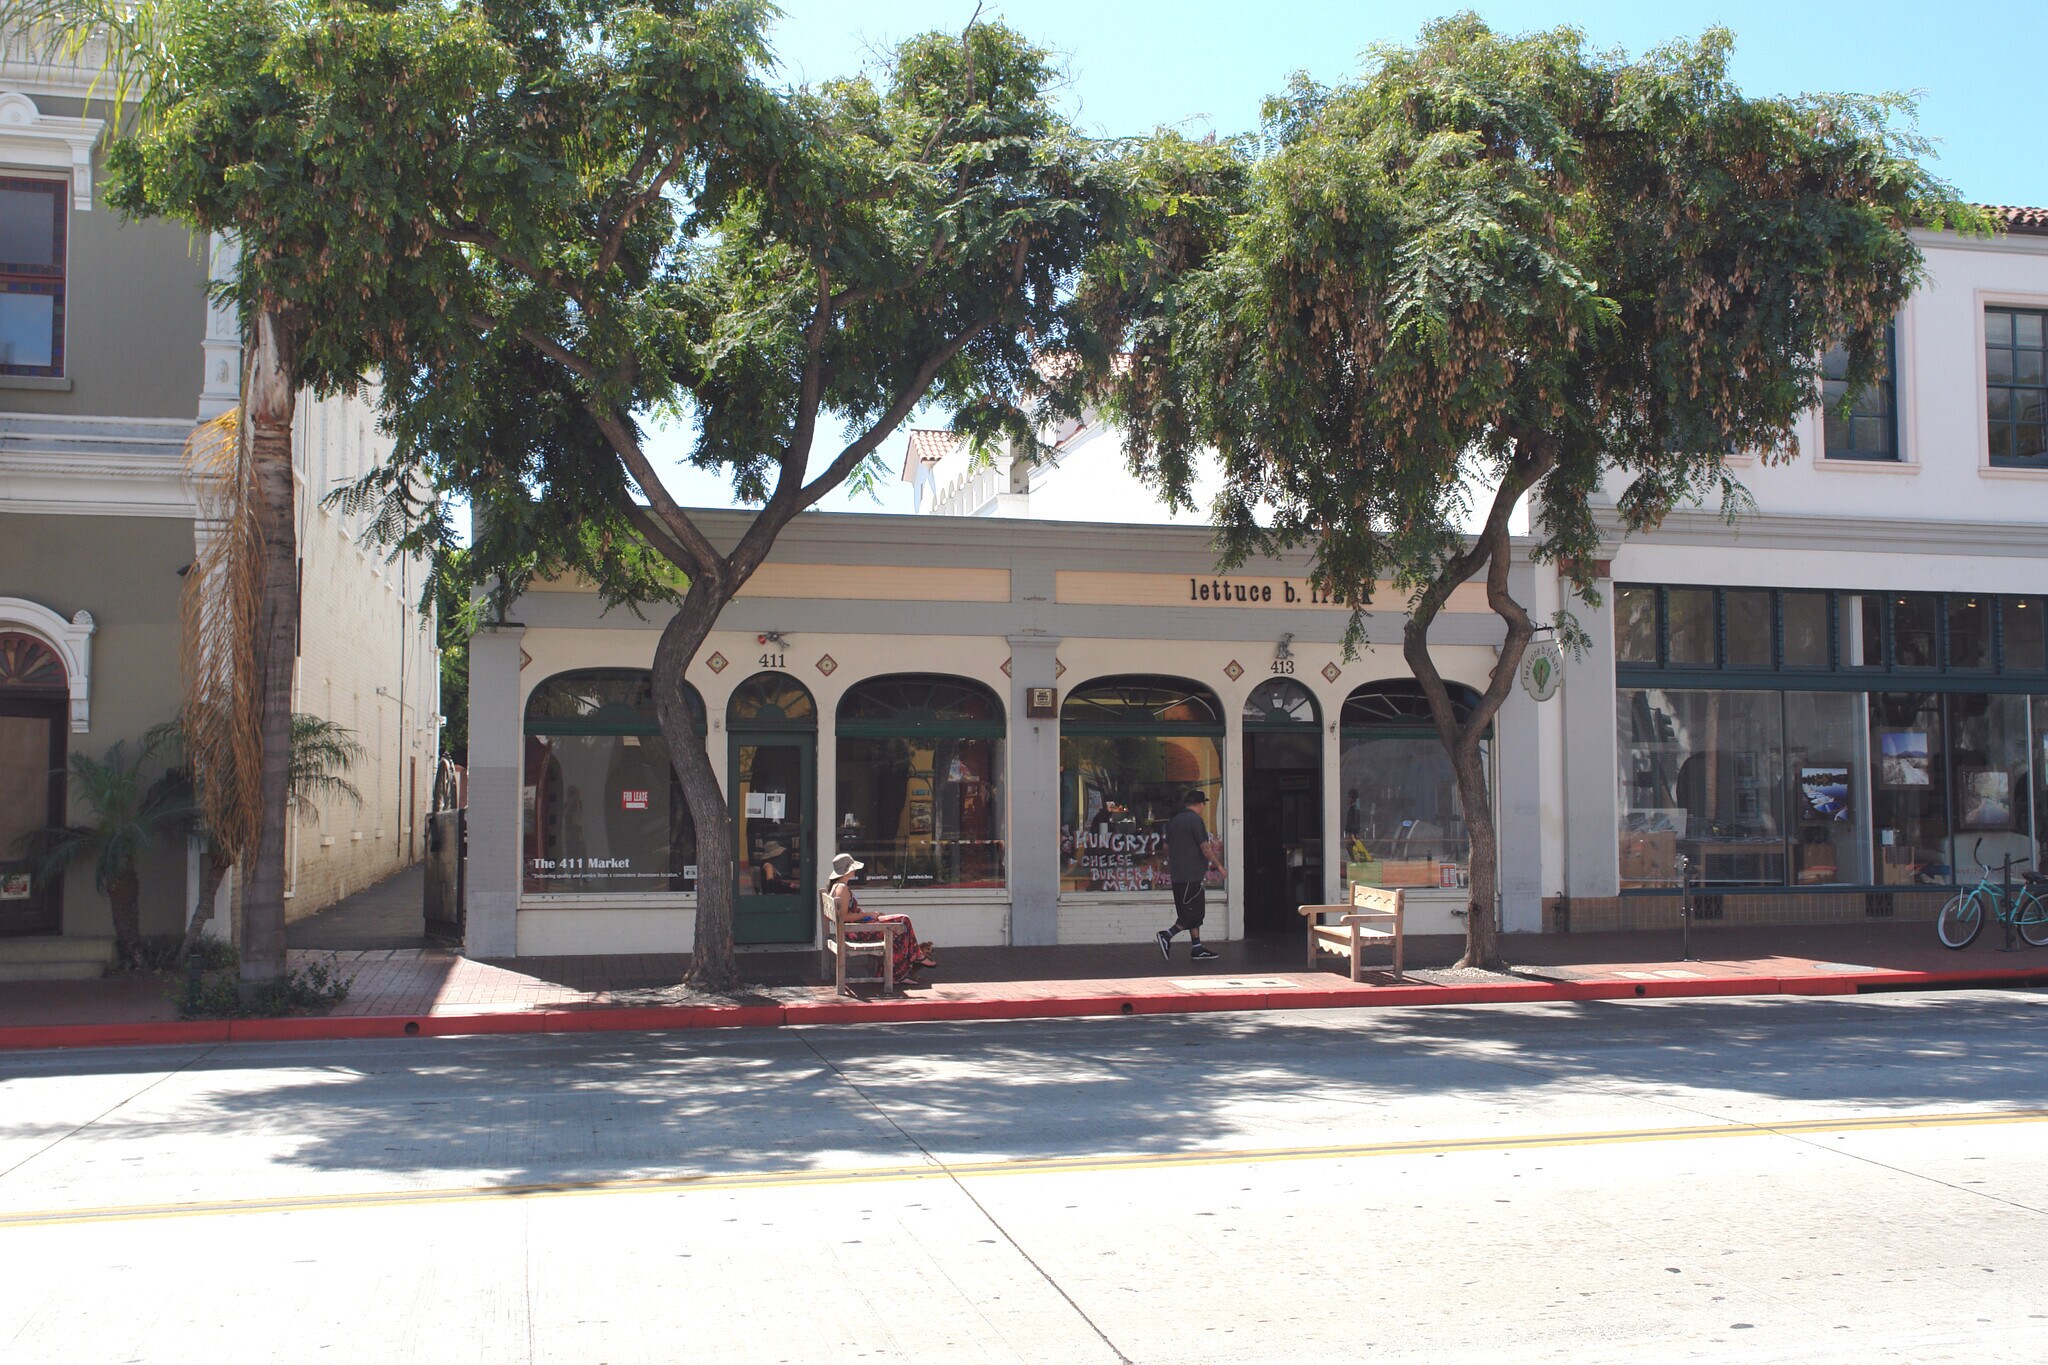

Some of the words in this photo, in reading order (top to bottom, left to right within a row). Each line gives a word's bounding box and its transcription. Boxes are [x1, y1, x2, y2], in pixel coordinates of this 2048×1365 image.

[1191, 578, 1271, 602] lettuce
[1284, 580, 1301, 603] b.
[758, 653, 786, 668] 411
[1270, 660, 1295, 674] 413
[623, 791, 632, 801] FOR
[633, 791, 648, 801] LEASE
[1075, 831, 1160, 855] HUNGRY?
[533, 858, 556, 869] The
[559, 858, 583, 869] 411
[588, 857, 630, 869] Market
[1081, 854, 1133, 867] CHEESE
[1090, 868, 1142, 881] BURGER
[1102, 879, 1149, 891] MEAL
